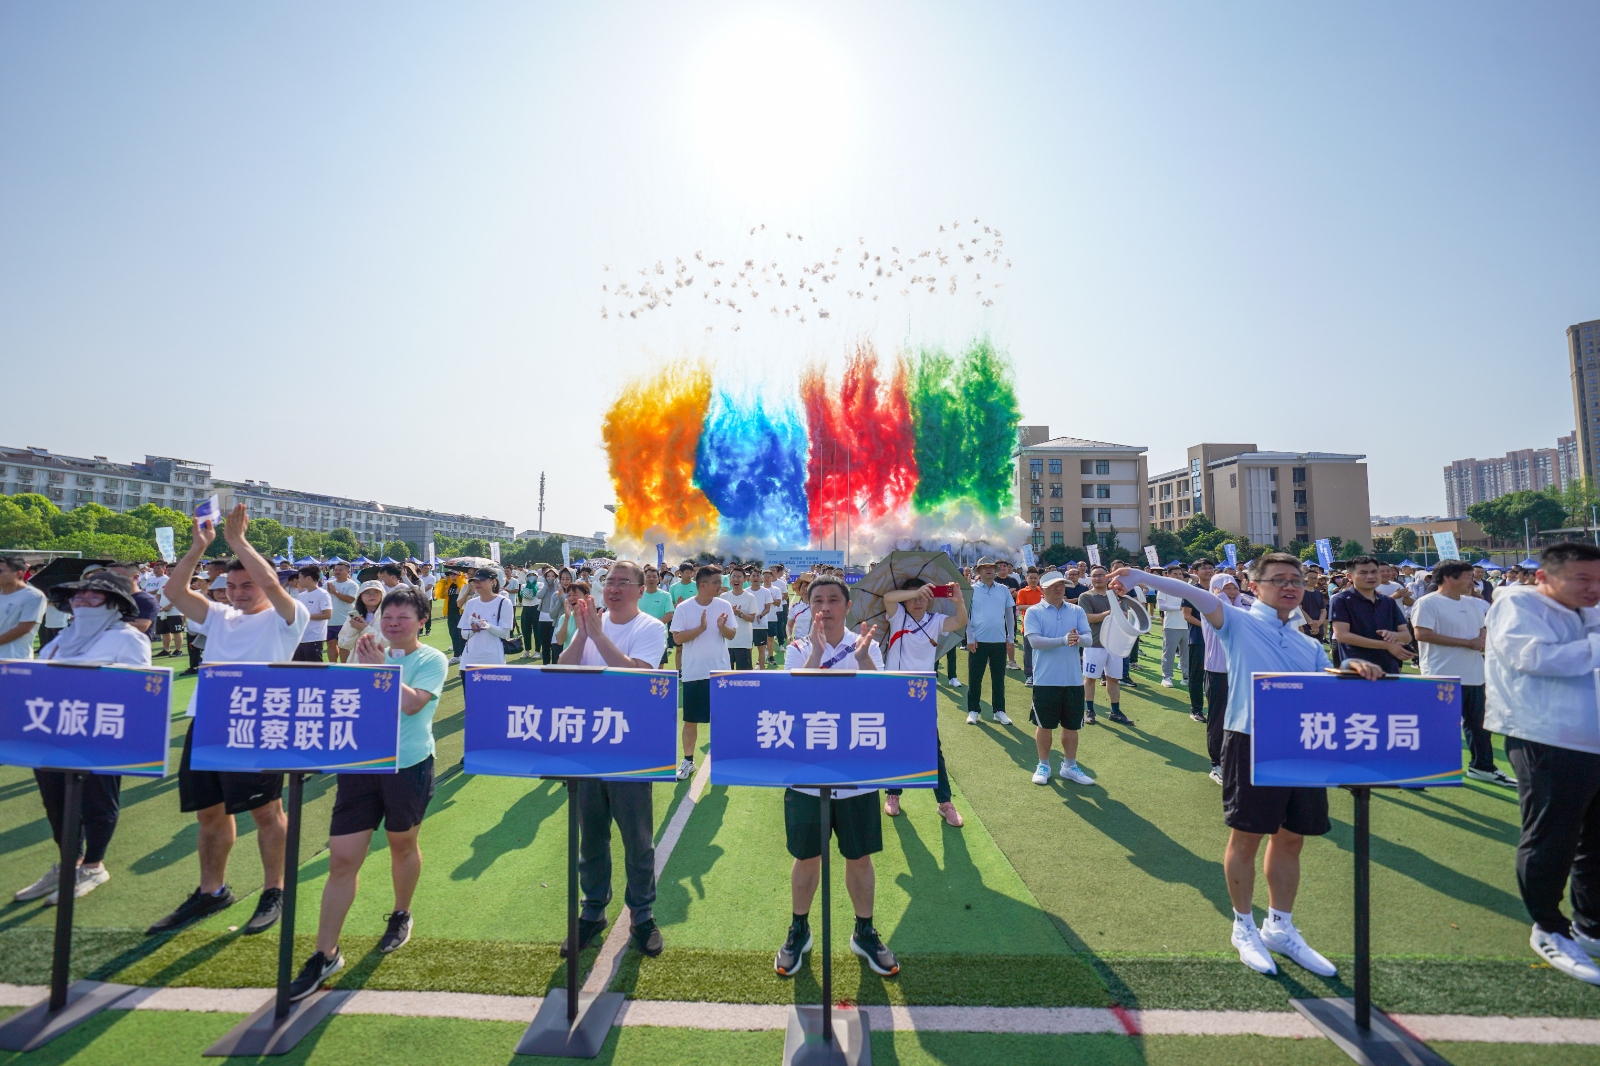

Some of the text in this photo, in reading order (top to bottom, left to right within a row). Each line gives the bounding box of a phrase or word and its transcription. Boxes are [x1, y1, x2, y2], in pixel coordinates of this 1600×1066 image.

[1085, 662, 1097, 674] 16
[23, 697, 125, 740] 文旅局
[229, 685, 362, 718] 纪委监委
[226, 718, 358, 751] 巡察联队
[506, 704, 630, 745] 政府办
[756, 709, 887, 751] 教育局
[1300, 712, 1420, 751] 税务局
